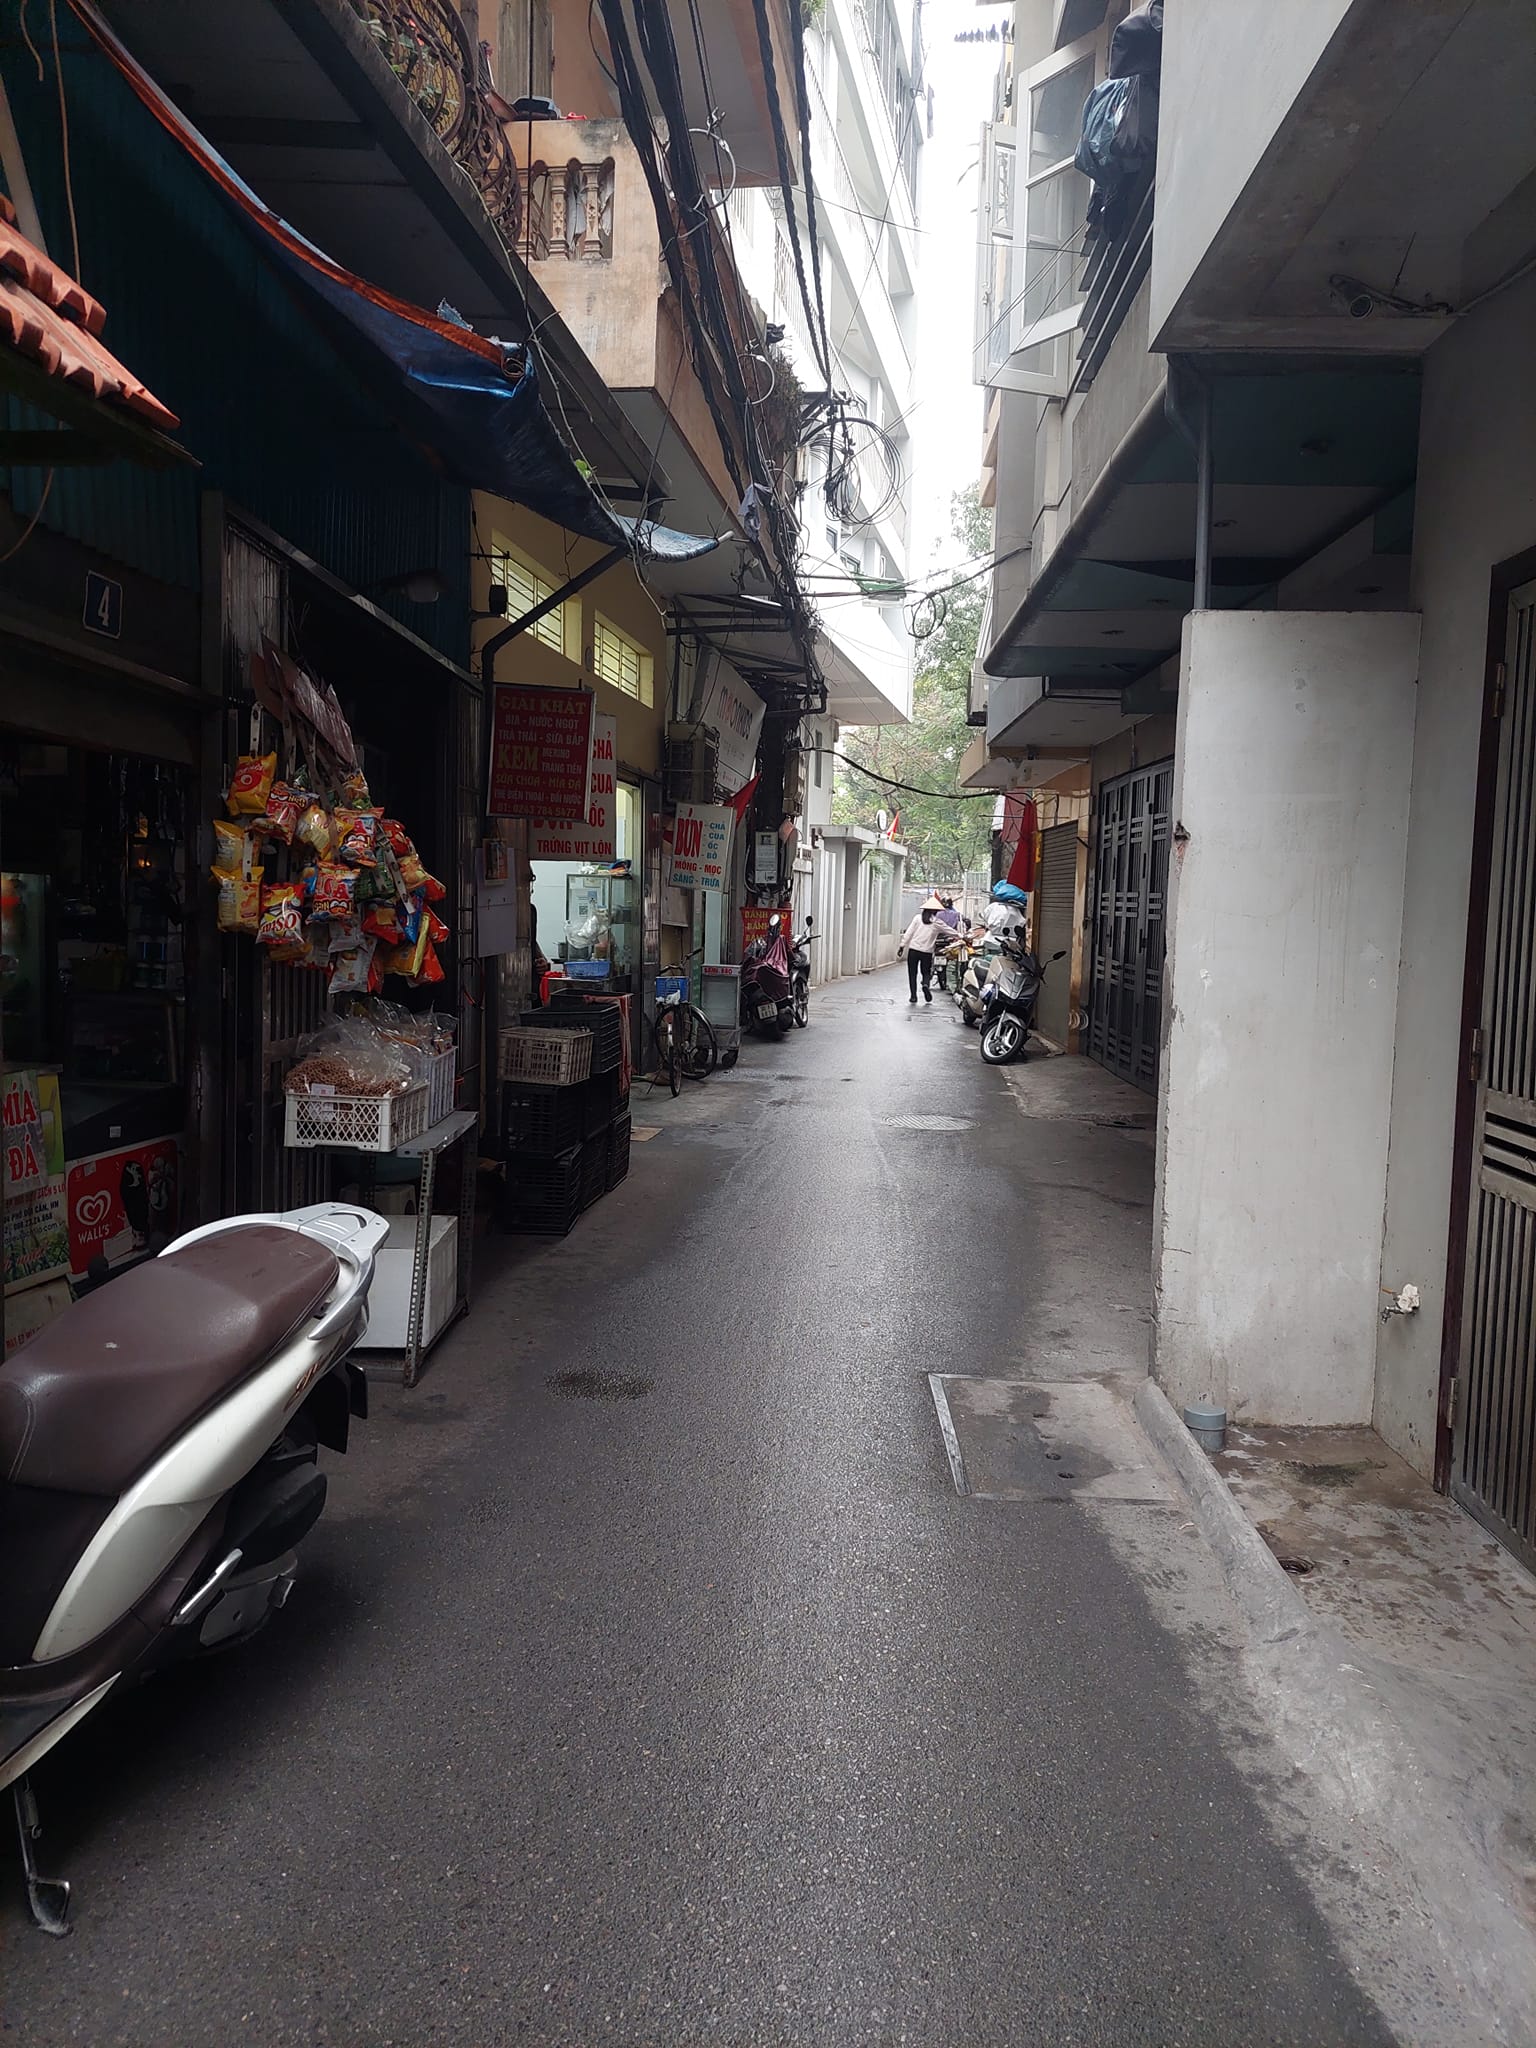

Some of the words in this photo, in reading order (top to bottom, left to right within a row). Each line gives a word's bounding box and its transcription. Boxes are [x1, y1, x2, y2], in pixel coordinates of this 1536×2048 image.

[97, 585, 110, 627] 4
[539, 697, 586, 716] KHÁT
[496, 744, 539, 771] KEM
[674, 807, 703, 858] BÚN
[708, 832, 725, 841] CUA
[537, 836, 572, 854] TRỨNG
[575, 840, 590, 857] VỊT
[592, 839, 612, 858] LỘN
[8, 1134, 40, 1181] ĐÁ
[78, 1224, 111, 1245] WALL'S
